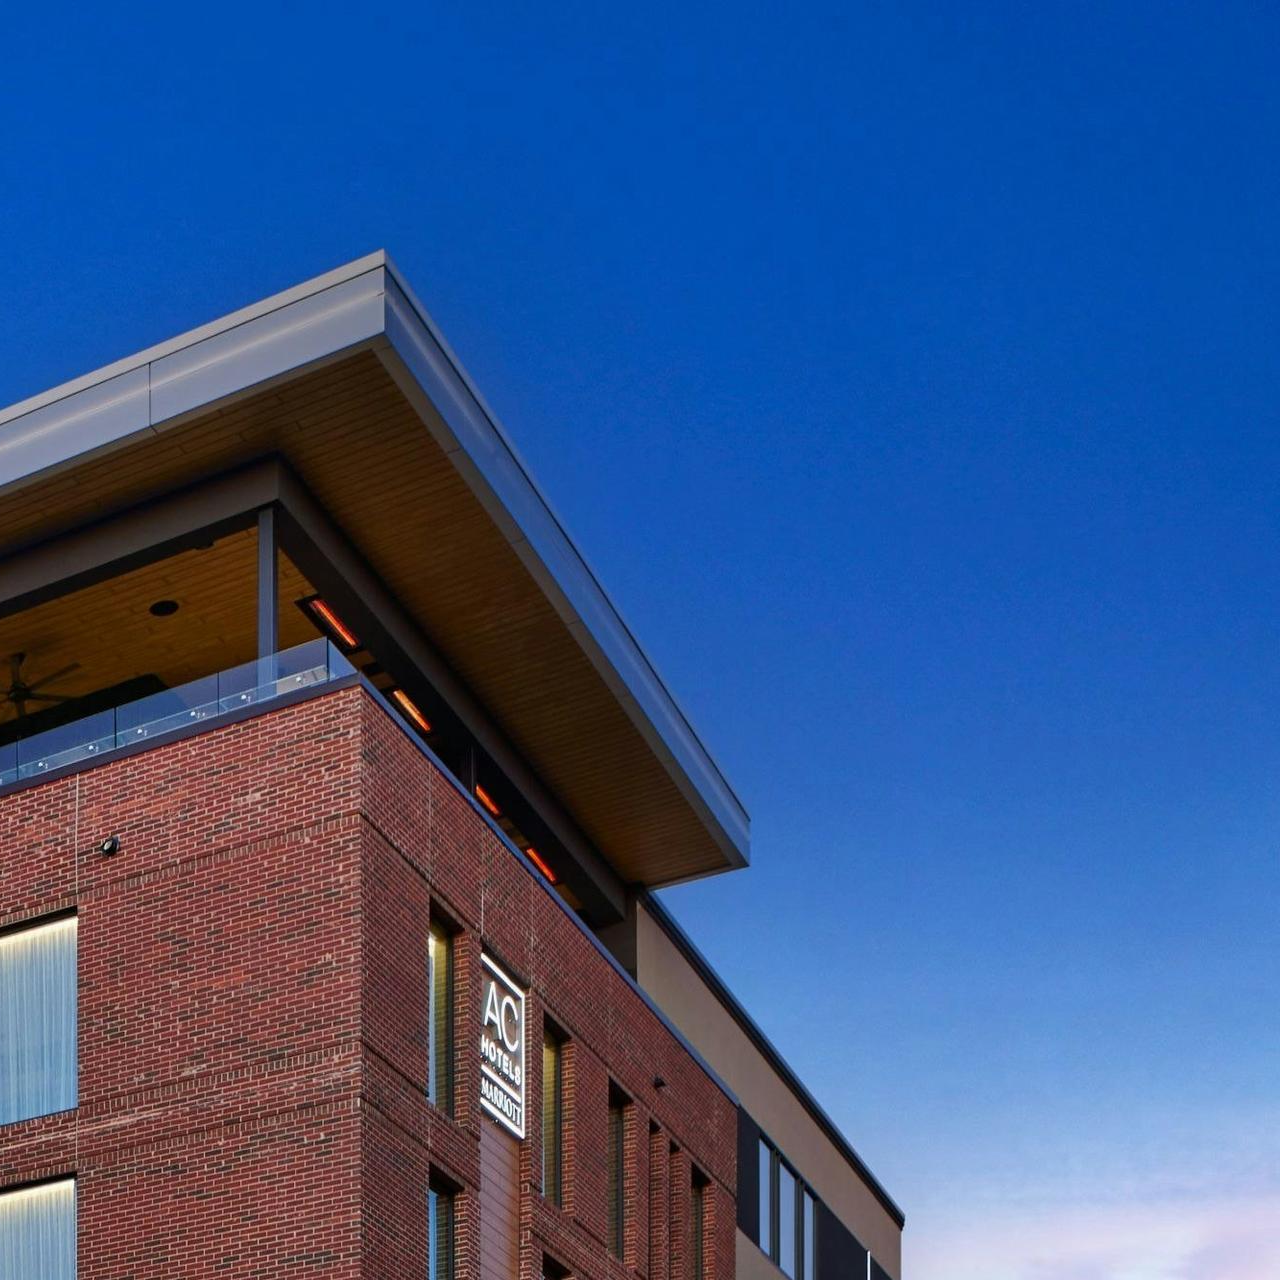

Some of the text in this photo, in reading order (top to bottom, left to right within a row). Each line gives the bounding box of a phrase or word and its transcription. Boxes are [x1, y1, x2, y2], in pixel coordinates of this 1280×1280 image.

[483, 981, 519, 1052] AC
[481, 1034, 521, 1086] HOTELS
[481, 1077, 521, 1126] MARRIOTT
